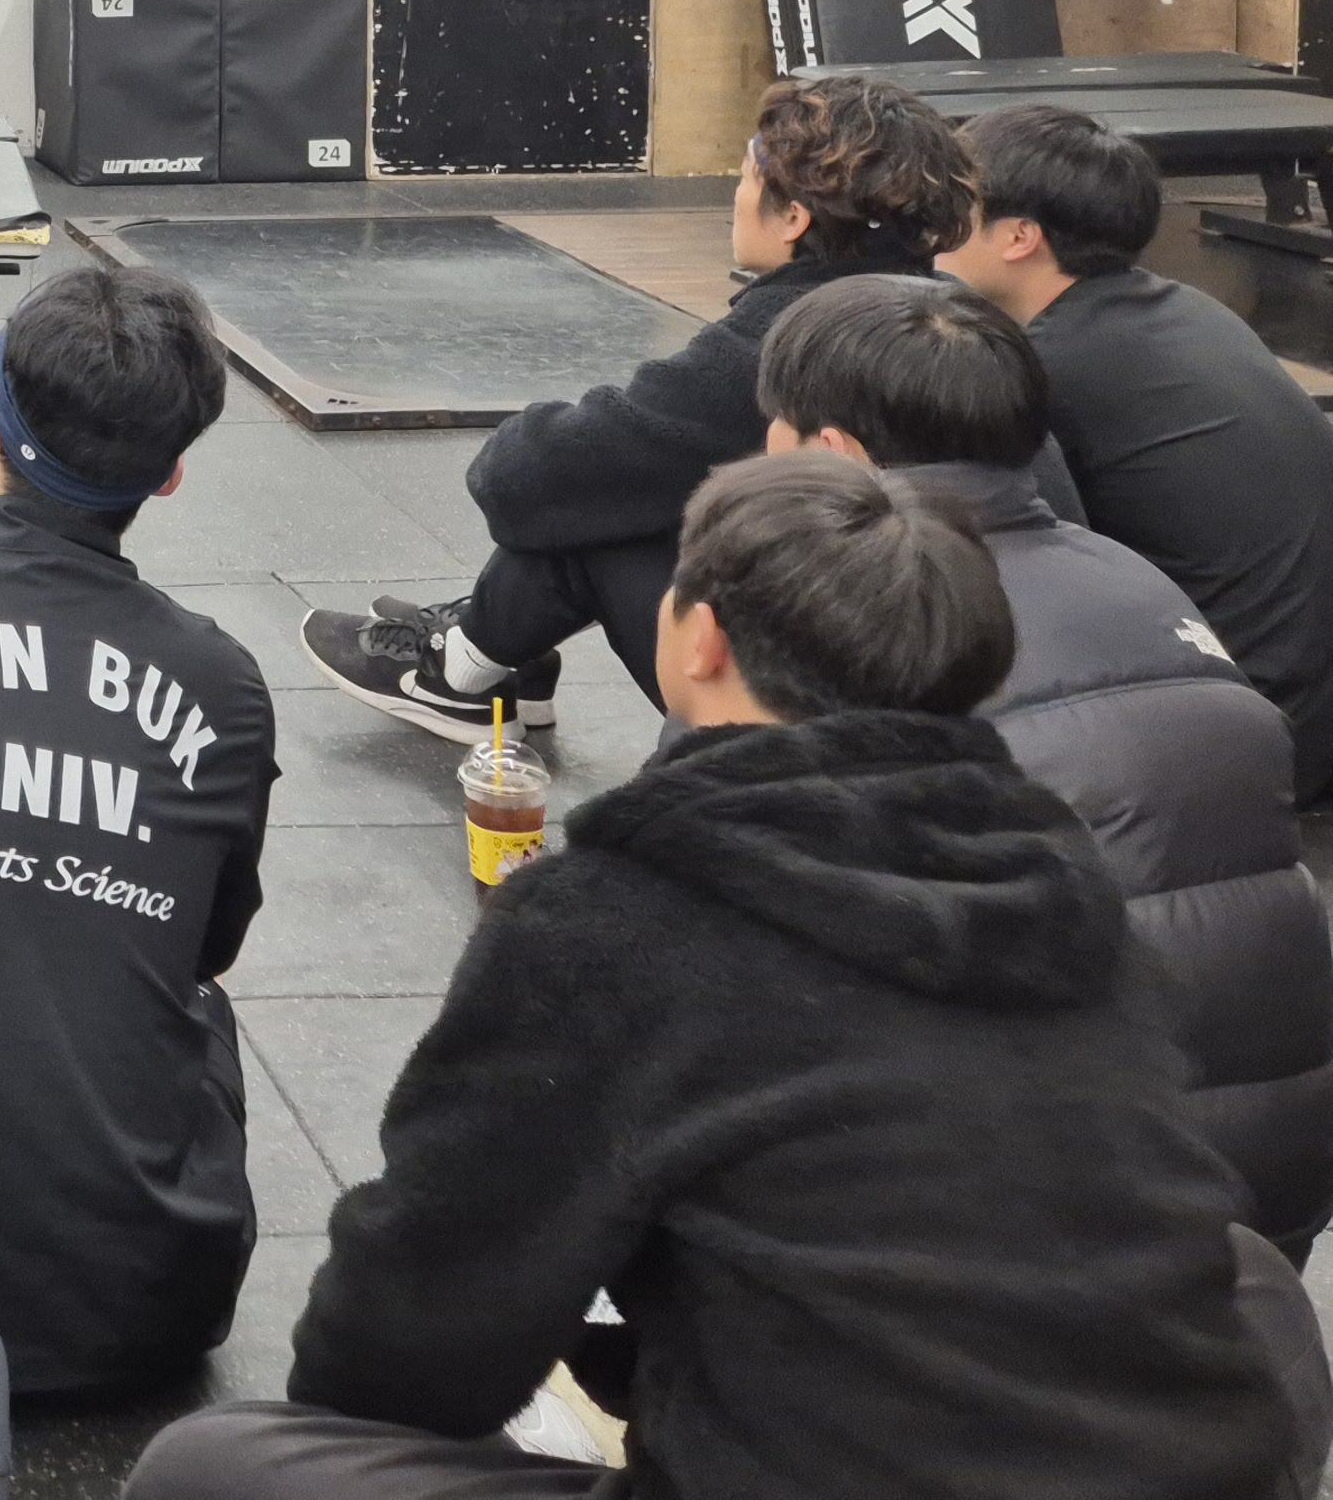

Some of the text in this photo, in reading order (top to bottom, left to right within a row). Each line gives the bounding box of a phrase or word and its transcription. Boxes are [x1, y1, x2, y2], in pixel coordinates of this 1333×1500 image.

[101, 156, 204, 174] XPODIUM
[318, 145, 341, 162] 24
[88, 638, 217, 792] BUK
[44, 855, 176, 922] Science
